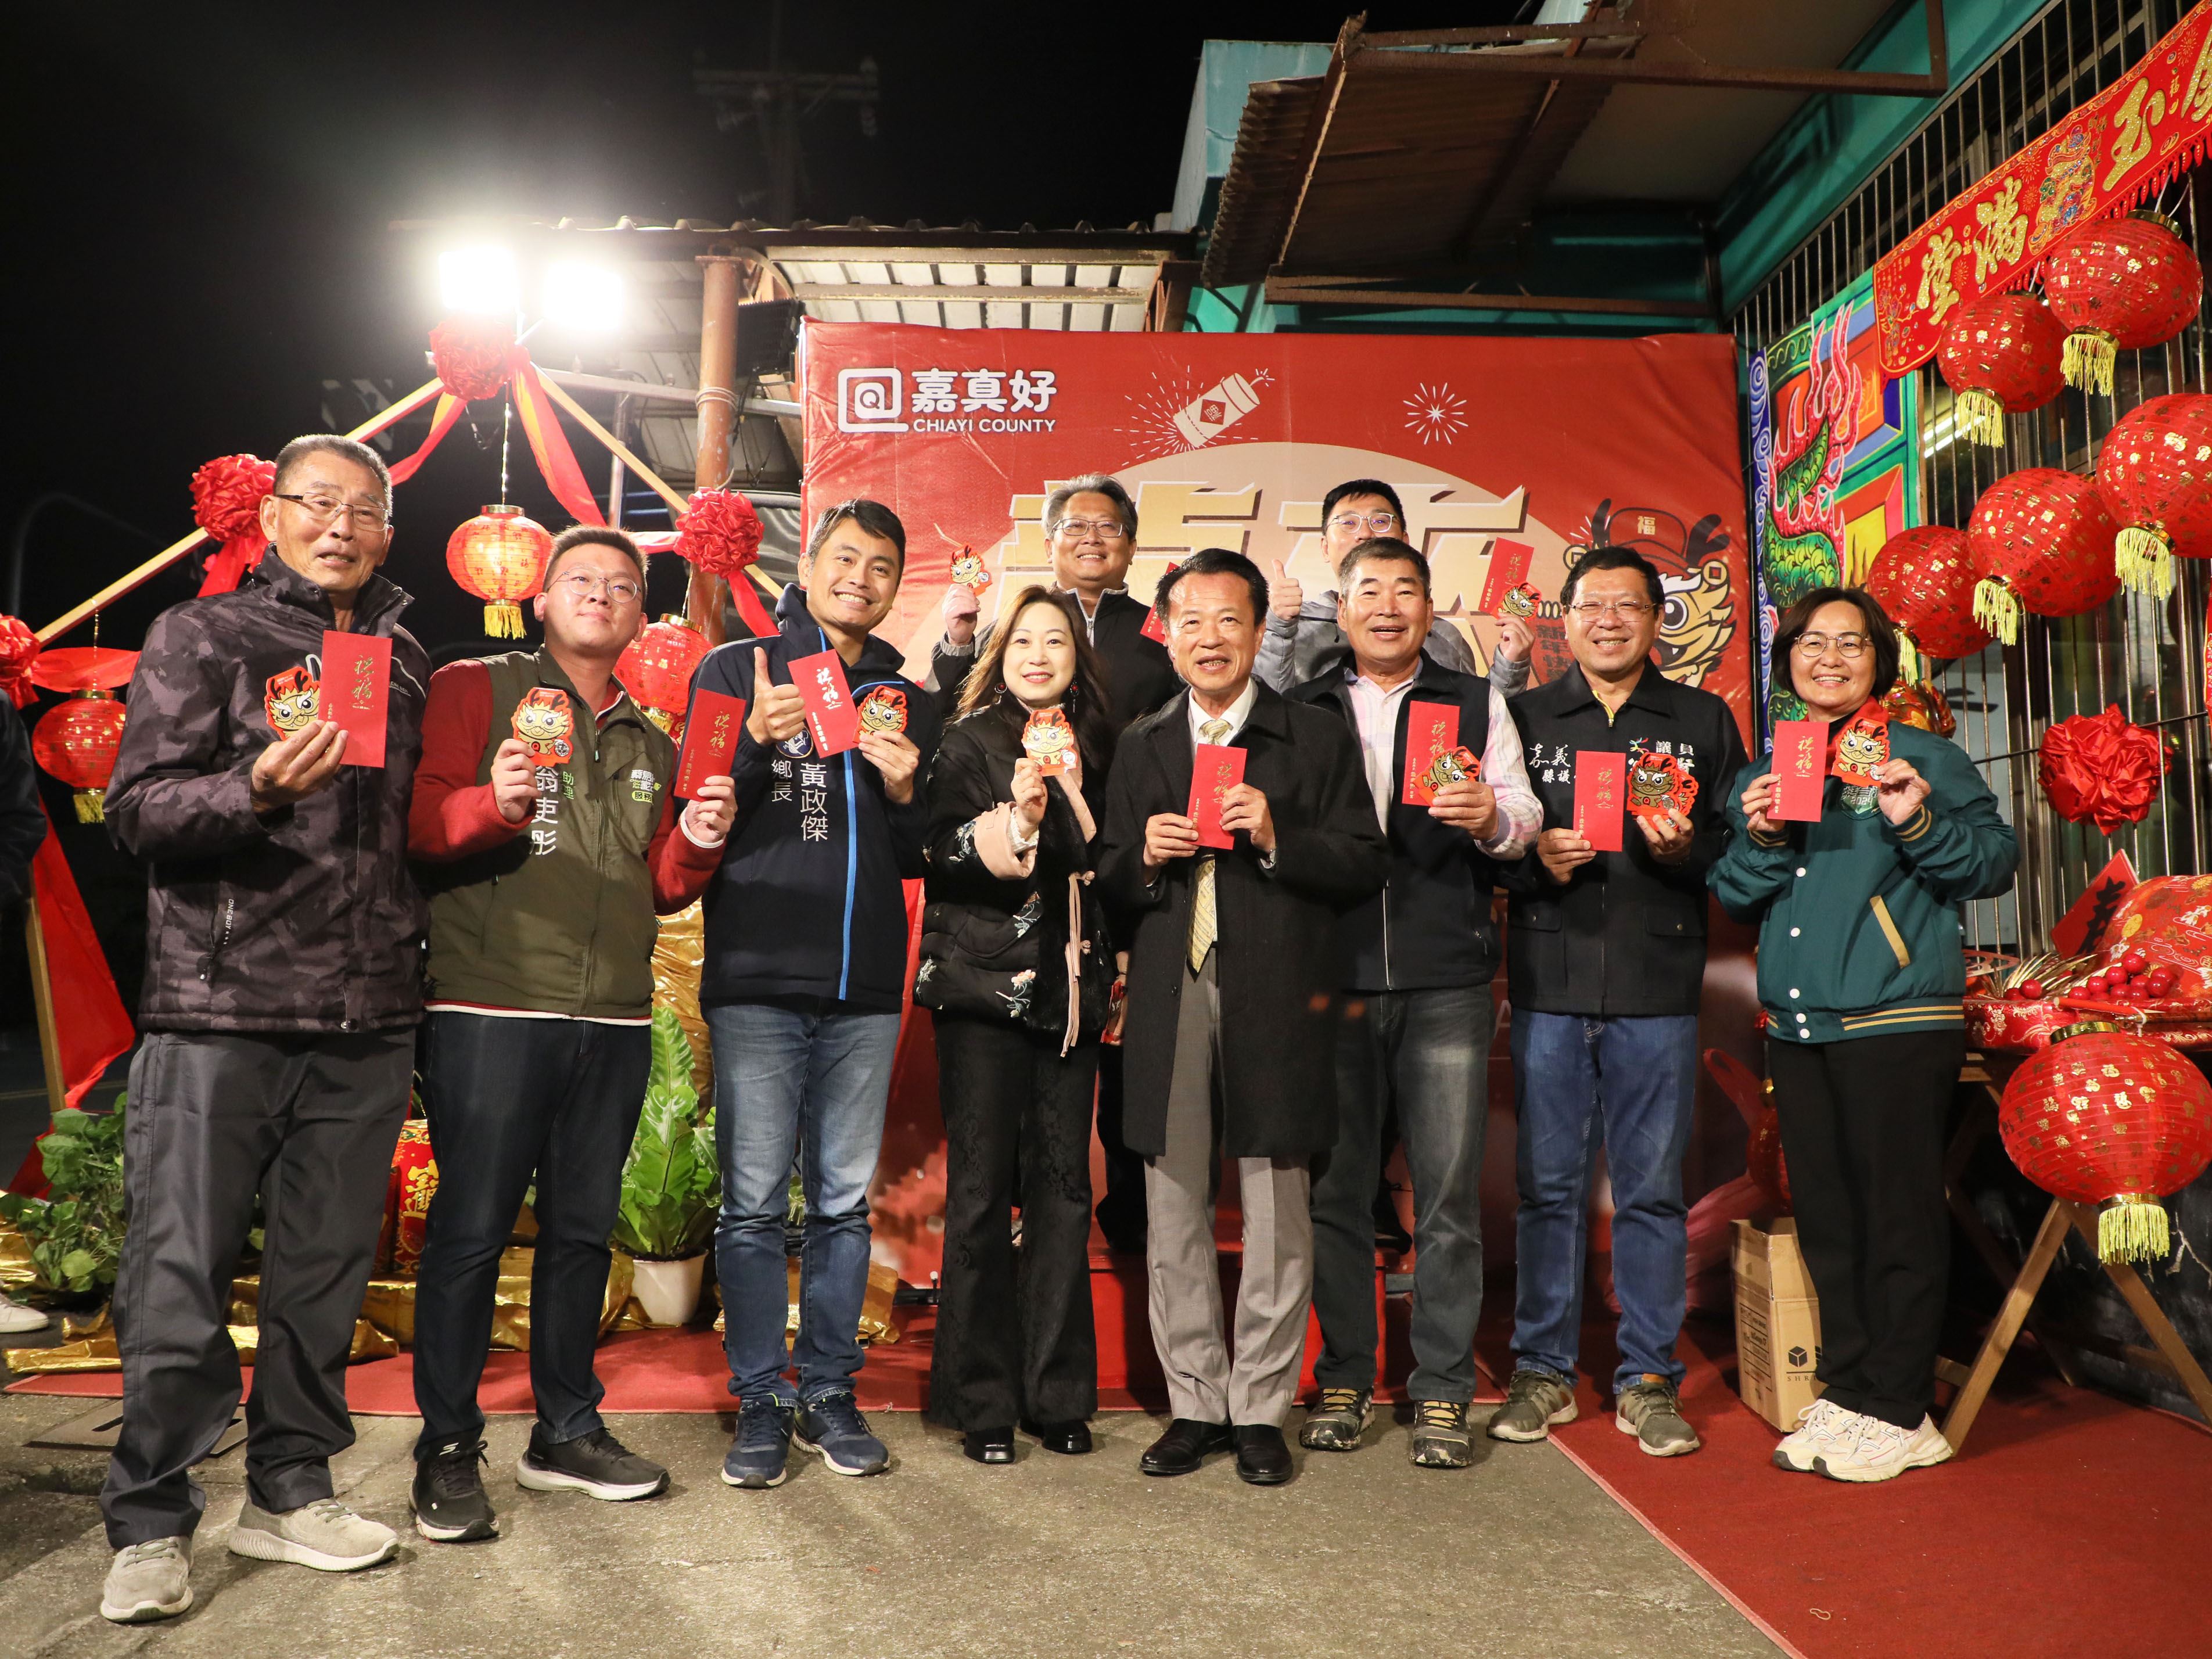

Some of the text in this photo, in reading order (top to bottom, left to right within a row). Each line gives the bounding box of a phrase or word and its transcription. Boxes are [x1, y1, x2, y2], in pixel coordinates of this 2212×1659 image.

[911, 368, 1057, 413] 嘉真好
[913, 418, 1056, 432] CHIAYI COUNTY
[1638, 516, 1656, 535] 福
[351, 655, 375, 699] 祝福
[816, 667, 839, 703] 祝福
[709, 710, 730, 749] 祝福
[1429, 720, 1446, 755] 祝福
[1529, 743, 1571, 768] 嘉義
[1656, 741, 1694, 756] 議員
[1796, 735, 1815, 770] 祝福
[771, 759, 793, 802] 鄉長
[1542, 769, 1577, 784] 縣議
[1597, 767, 1613, 801] 祝福
[800, 762, 828, 842] 黃政傑
[1851, 796, 1873, 806] 2024
